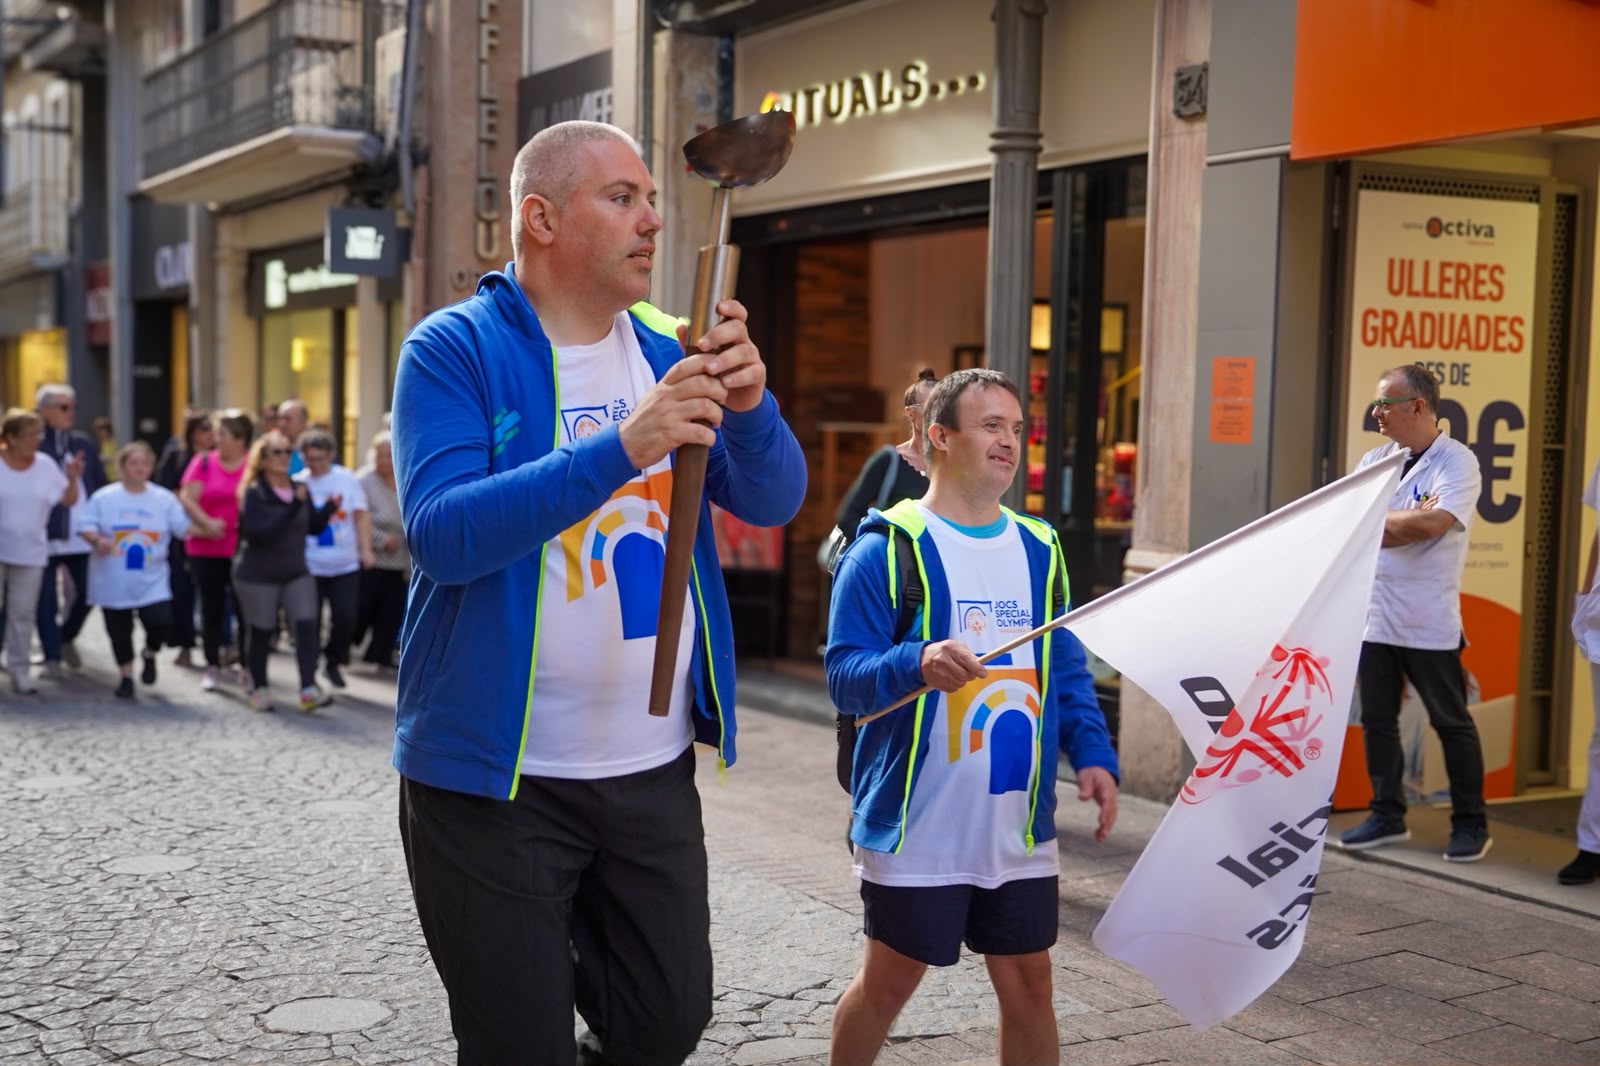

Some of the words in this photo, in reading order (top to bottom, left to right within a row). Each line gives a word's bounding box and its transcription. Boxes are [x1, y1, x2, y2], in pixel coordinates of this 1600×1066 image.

[764, 61, 984, 130] ITUALS...
[1387, 256, 1505, 302] ULLERES
[1361, 307, 1525, 354] GRADUADES
[1415, 362, 1446, 385] ES
[1450, 363, 1471, 386] DE
[994, 600, 1018, 609] JOCS
[995, 609, 1031, 618] SPECIAL
